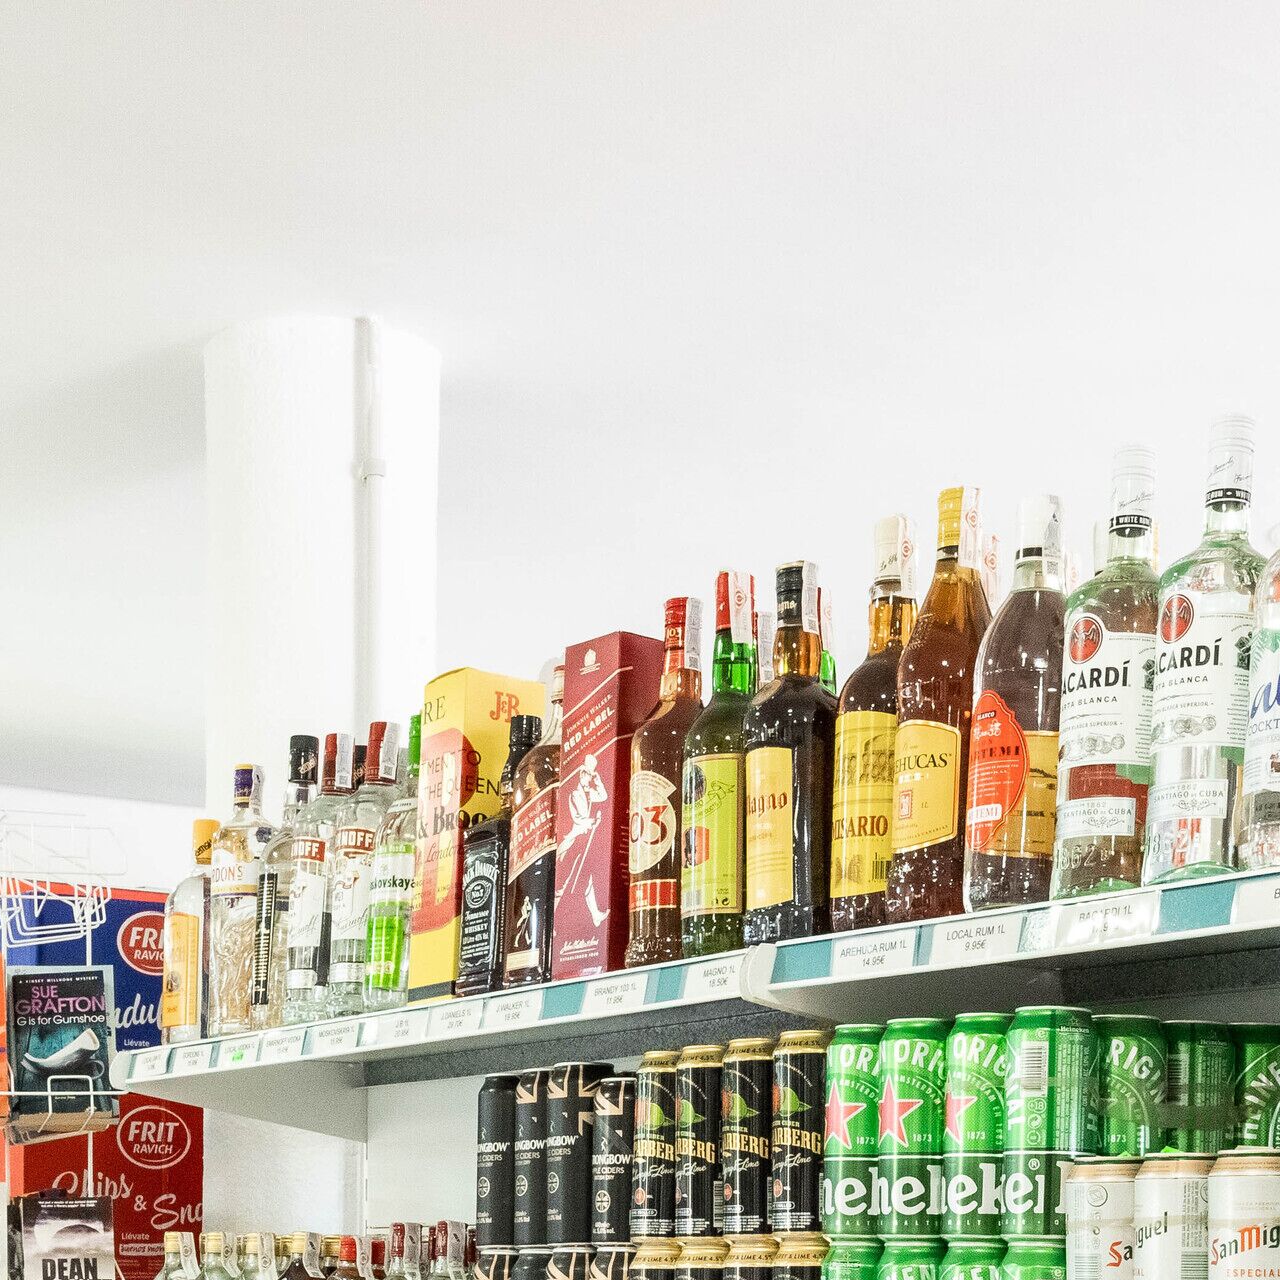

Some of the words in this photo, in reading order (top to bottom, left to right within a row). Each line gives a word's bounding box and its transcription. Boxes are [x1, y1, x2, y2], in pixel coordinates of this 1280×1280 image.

[1068, 660, 1130, 692] ACARDÍ
[564, 732, 581, 752] RED
[584, 707, 614, 736] LABEL
[947, 929, 973, 941] LOCAL
[976, 926, 994, 937] RUM
[997, 925, 1006, 934] 1L
[703, 966, 727, 978] MAGNO
[32, 985, 58, 998] SUE
[15, 996, 104, 1014] GRAFTON
[17, 1016, 27, 1026] G
[29, 1016, 35, 1025] is
[37, 1016, 51, 1025] for
[53, 1014, 105, 1024] Gumshoe
[128, 1121, 179, 1142] FRIT
[133, 1144, 173, 1154] RAVICH
[42, 1258, 98, 1280] DEAN
